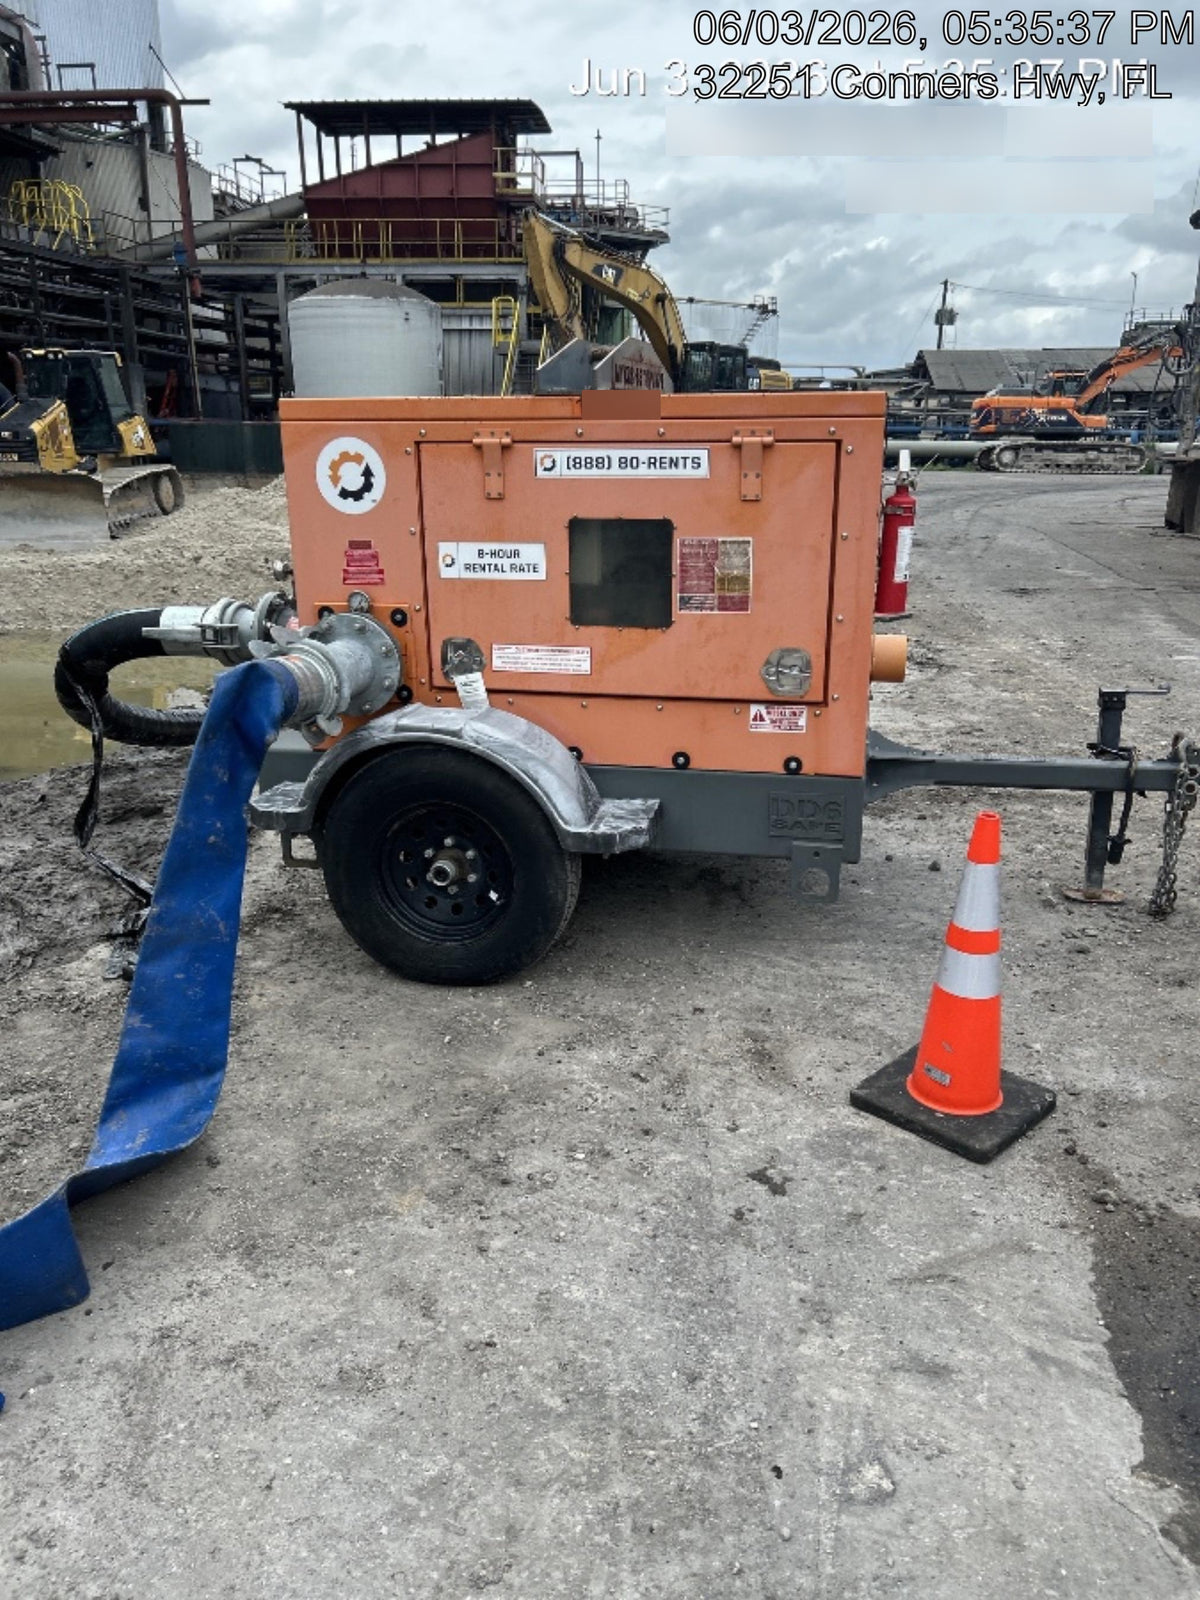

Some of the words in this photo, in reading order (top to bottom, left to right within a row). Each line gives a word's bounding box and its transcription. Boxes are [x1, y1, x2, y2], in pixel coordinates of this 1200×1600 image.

[566, 455, 612, 470] (888)
[618, 455, 702, 470] 80-RENTS
[463, 563, 507, 573] RENTAL
[509, 563, 540, 573] RATE
